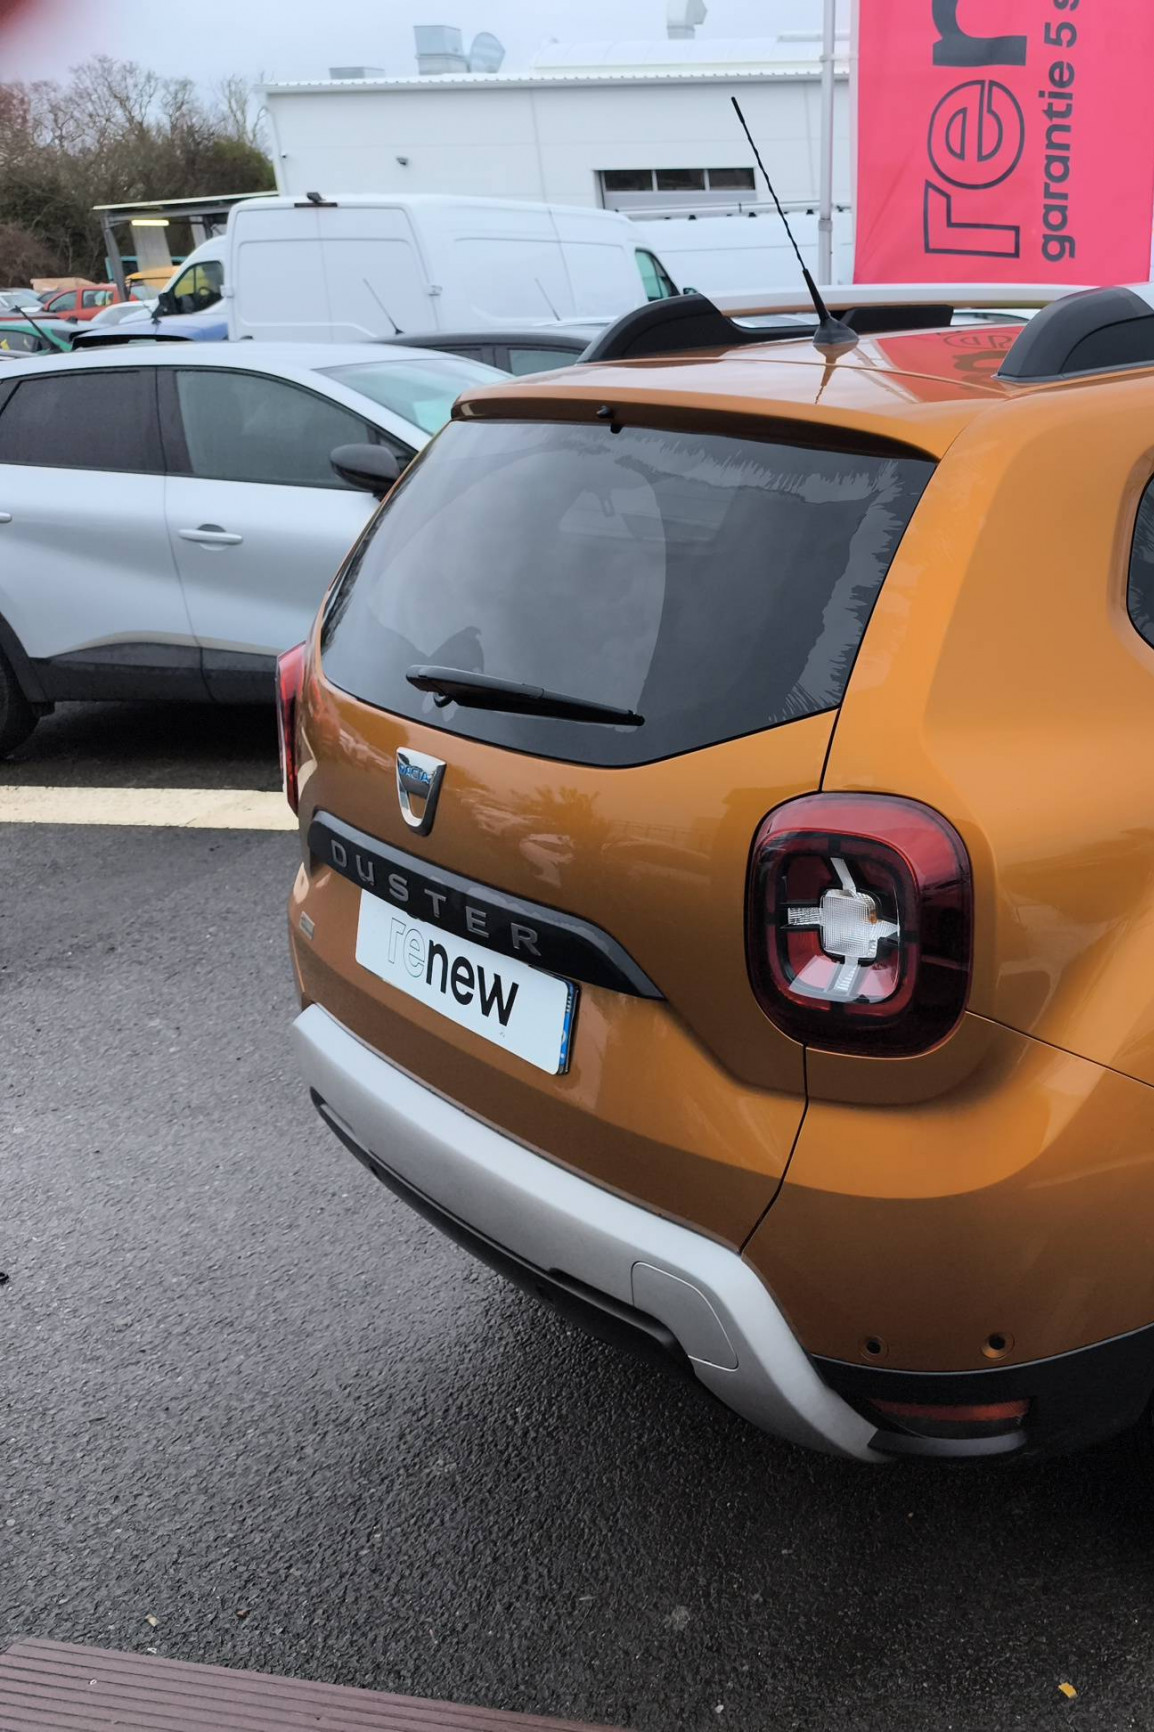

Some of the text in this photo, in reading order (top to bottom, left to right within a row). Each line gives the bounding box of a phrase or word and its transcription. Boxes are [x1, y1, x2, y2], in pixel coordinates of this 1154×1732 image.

[1044, 22, 1077, 48] 5
[1038, 61, 1076, 262] garantie
[331, 840, 541, 956] DUSTER
[388, 917, 519, 1027] renew
